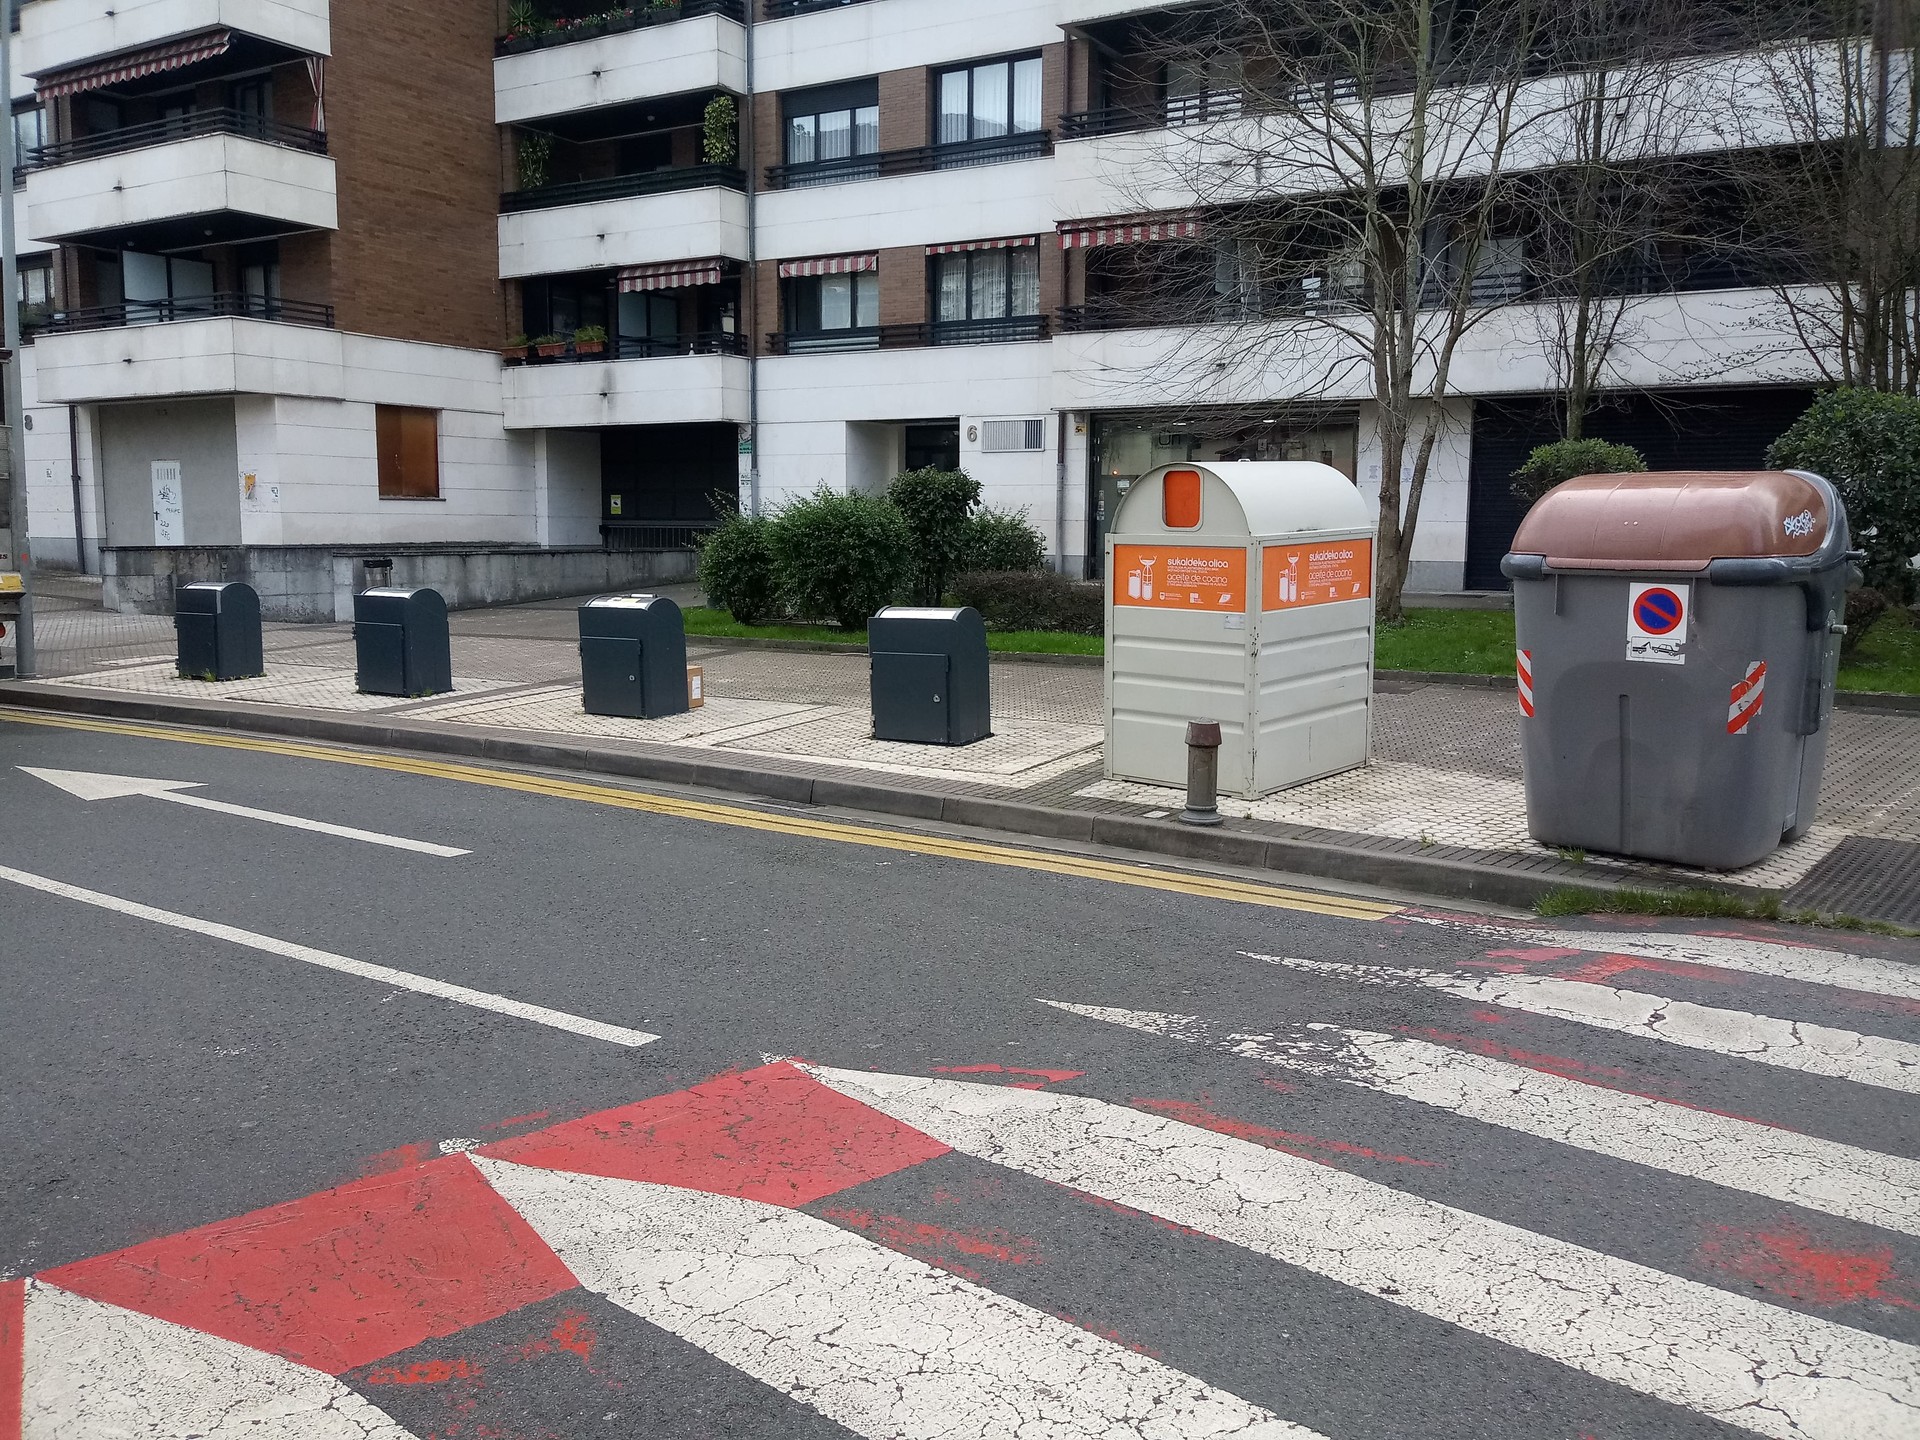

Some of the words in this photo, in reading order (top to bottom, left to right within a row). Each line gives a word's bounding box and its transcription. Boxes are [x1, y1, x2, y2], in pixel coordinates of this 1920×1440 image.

[967, 425, 977, 442] 6
[1167, 557, 1208, 567] sukaldeko
[1208, 559, 1229, 568] olioa
[1167, 573, 1190, 581] aceite
[1191, 574, 1201, 582] de
[1202, 576, 1228, 584] cocina
[1309, 570, 1326, 580] aceite
[1327, 569, 1335, 579] de
